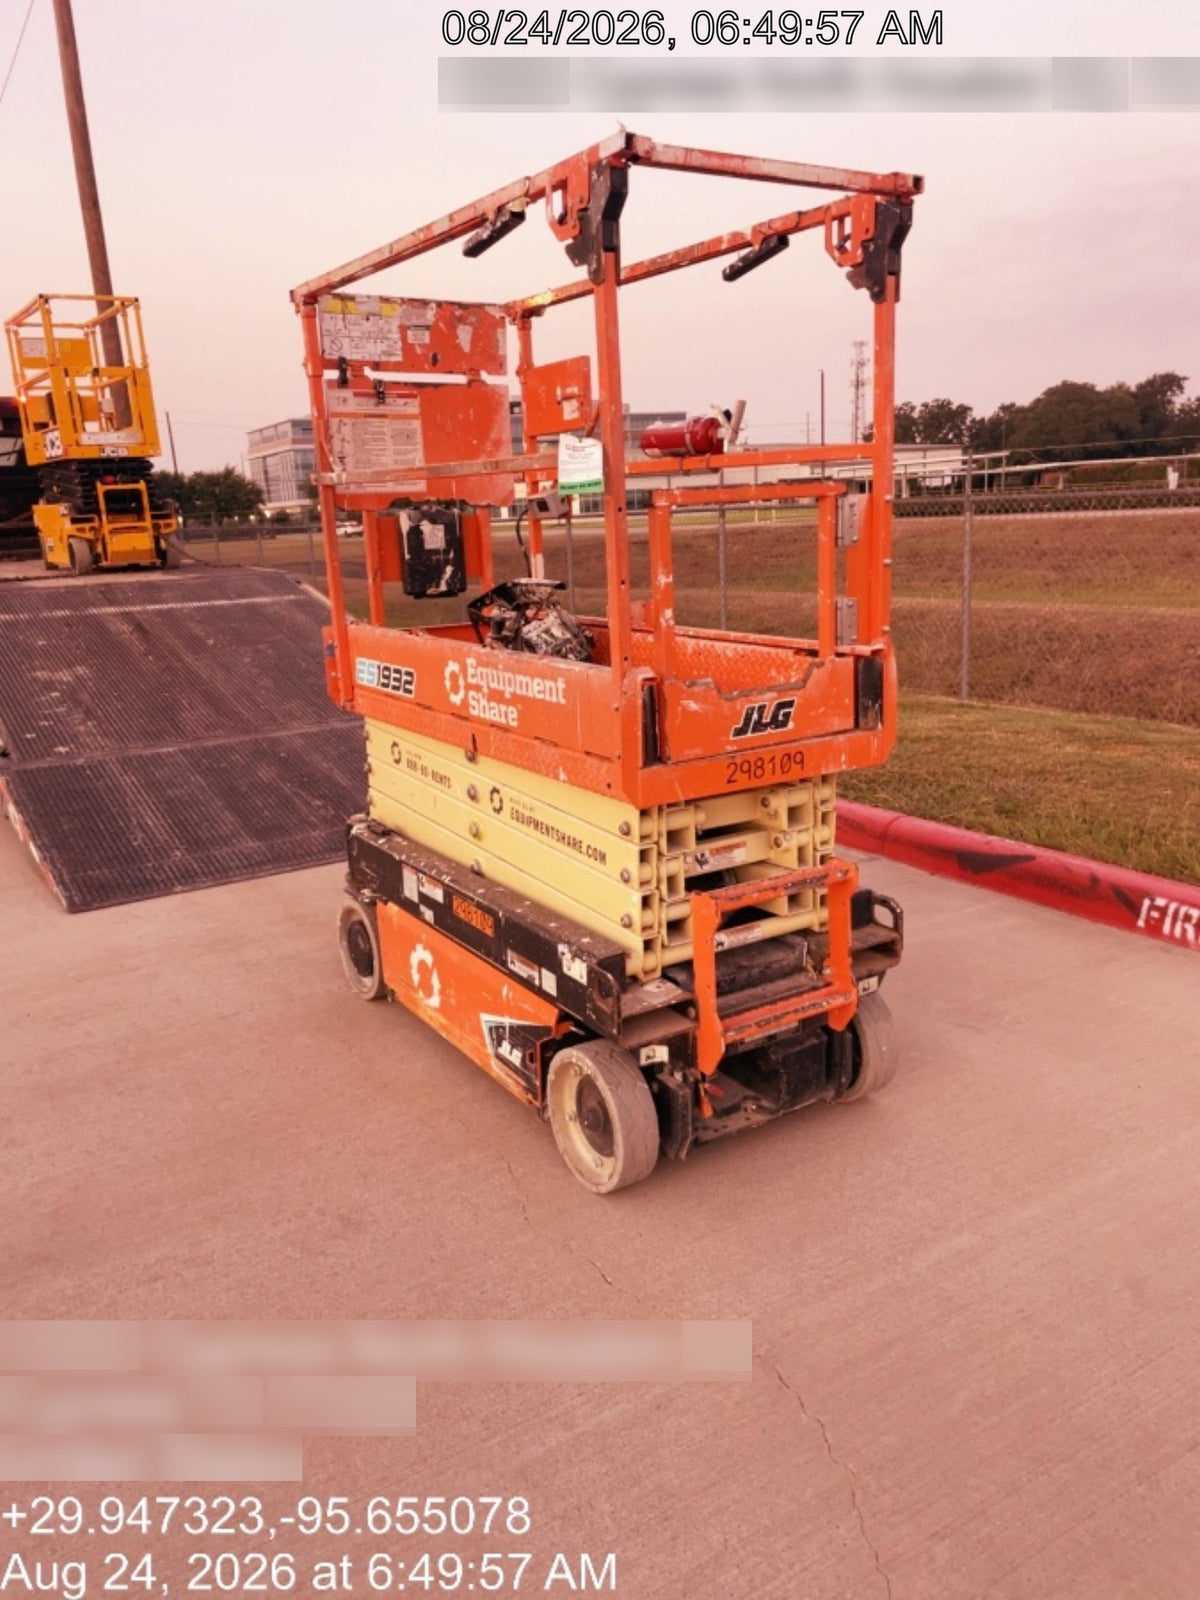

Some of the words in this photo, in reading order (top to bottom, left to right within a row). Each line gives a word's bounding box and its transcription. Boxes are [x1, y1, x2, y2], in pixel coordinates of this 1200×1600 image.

[356, 658, 415, 697] ES1932
[466, 657, 566, 705] Equipment
[467, 690, 519, 727] Share
[730, 697, 796, 739] JLG
[726, 750, 805, 784] 298109
[509, 806, 607, 866] EQUIPMENTSHARE.COM
[1136, 896, 1200, 946] FIR
